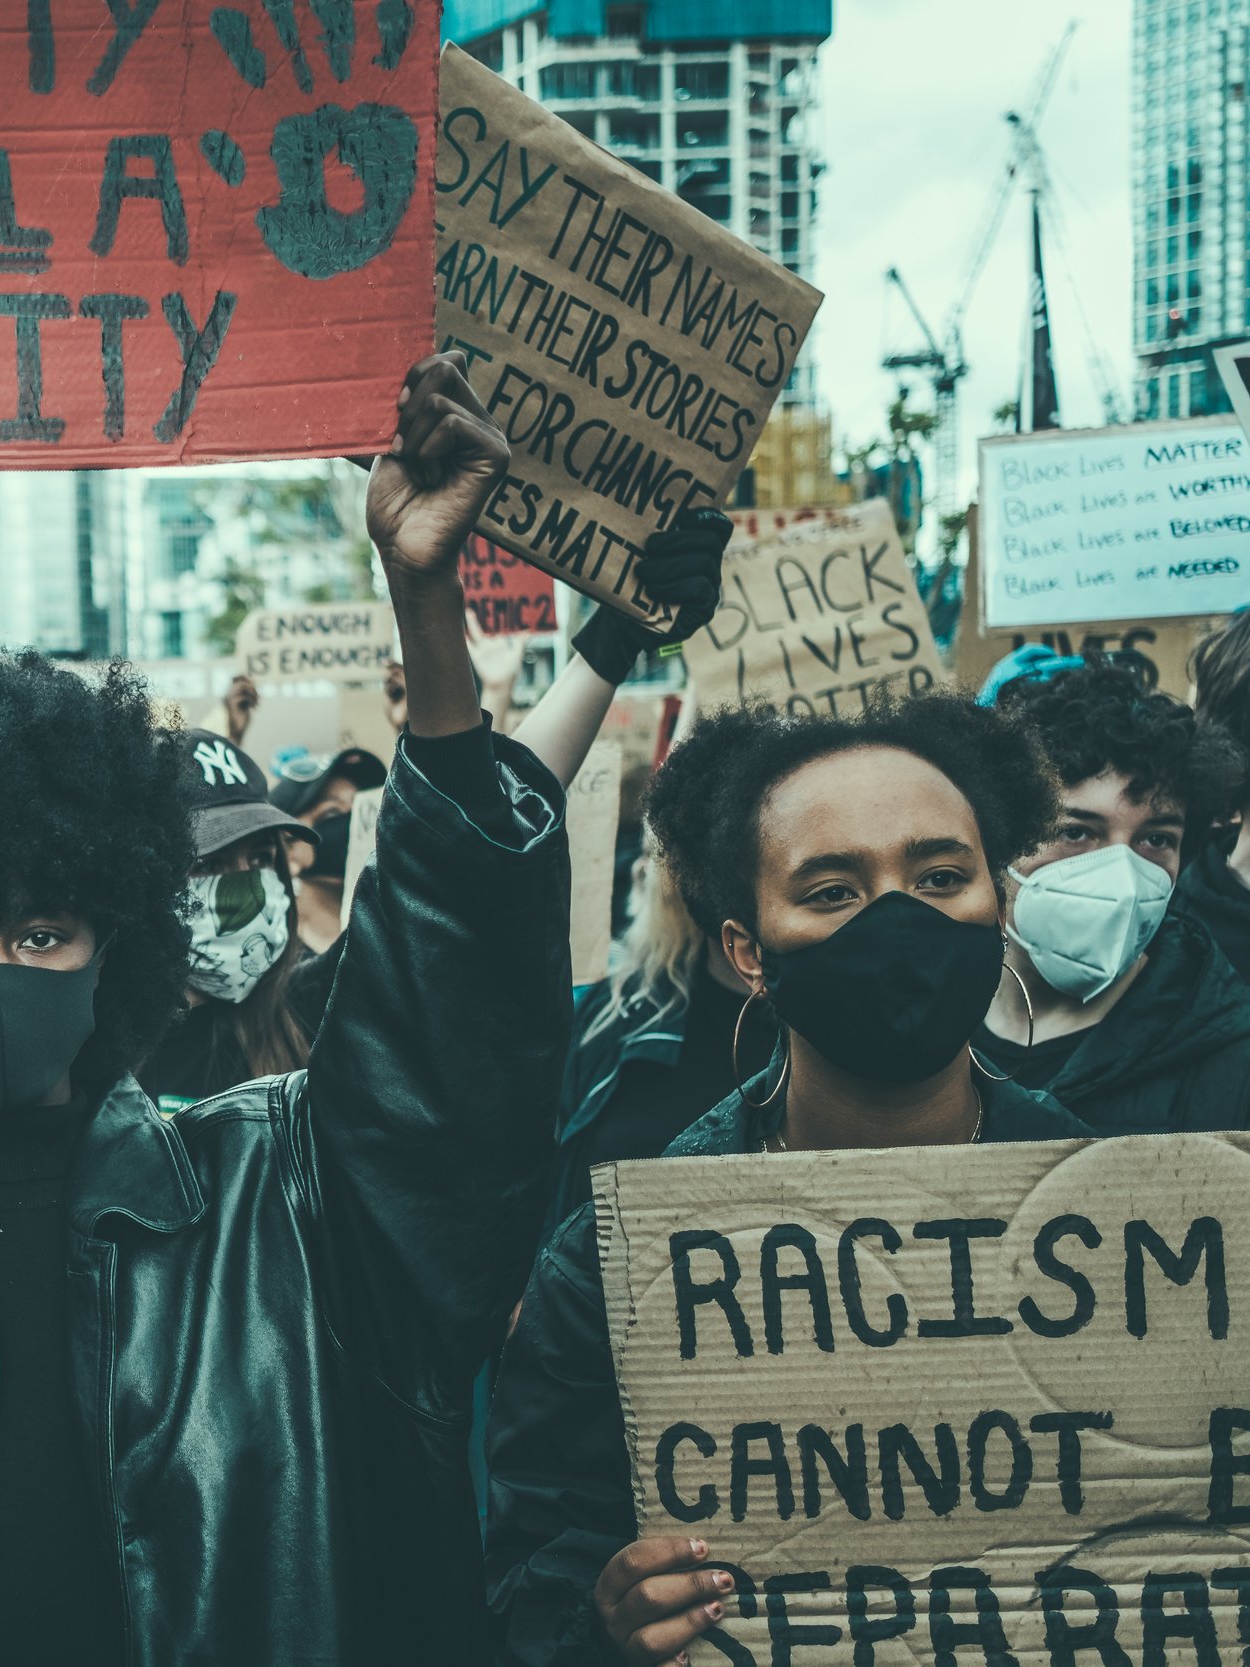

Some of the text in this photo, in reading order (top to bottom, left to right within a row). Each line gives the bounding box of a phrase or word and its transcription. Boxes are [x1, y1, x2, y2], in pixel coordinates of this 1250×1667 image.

[90, 134, 187, 265] A
[436, 106, 797, 388] SAY THEIR NAMES
[435, 222, 756, 463] ARN THEIR STORIES
[485, 362, 576, 465] FOR
[1144, 438, 1242, 469] MATTER
[1167, 557, 1240, 579] NEEDED
[246, 651, 270, 677] IS
[257, 611, 372, 642] ENOUGH
[193, 740, 248, 786] NY
[668, 1213, 1230, 1360] RACISM
[654, 1409, 1114, 1523] CANNOT
